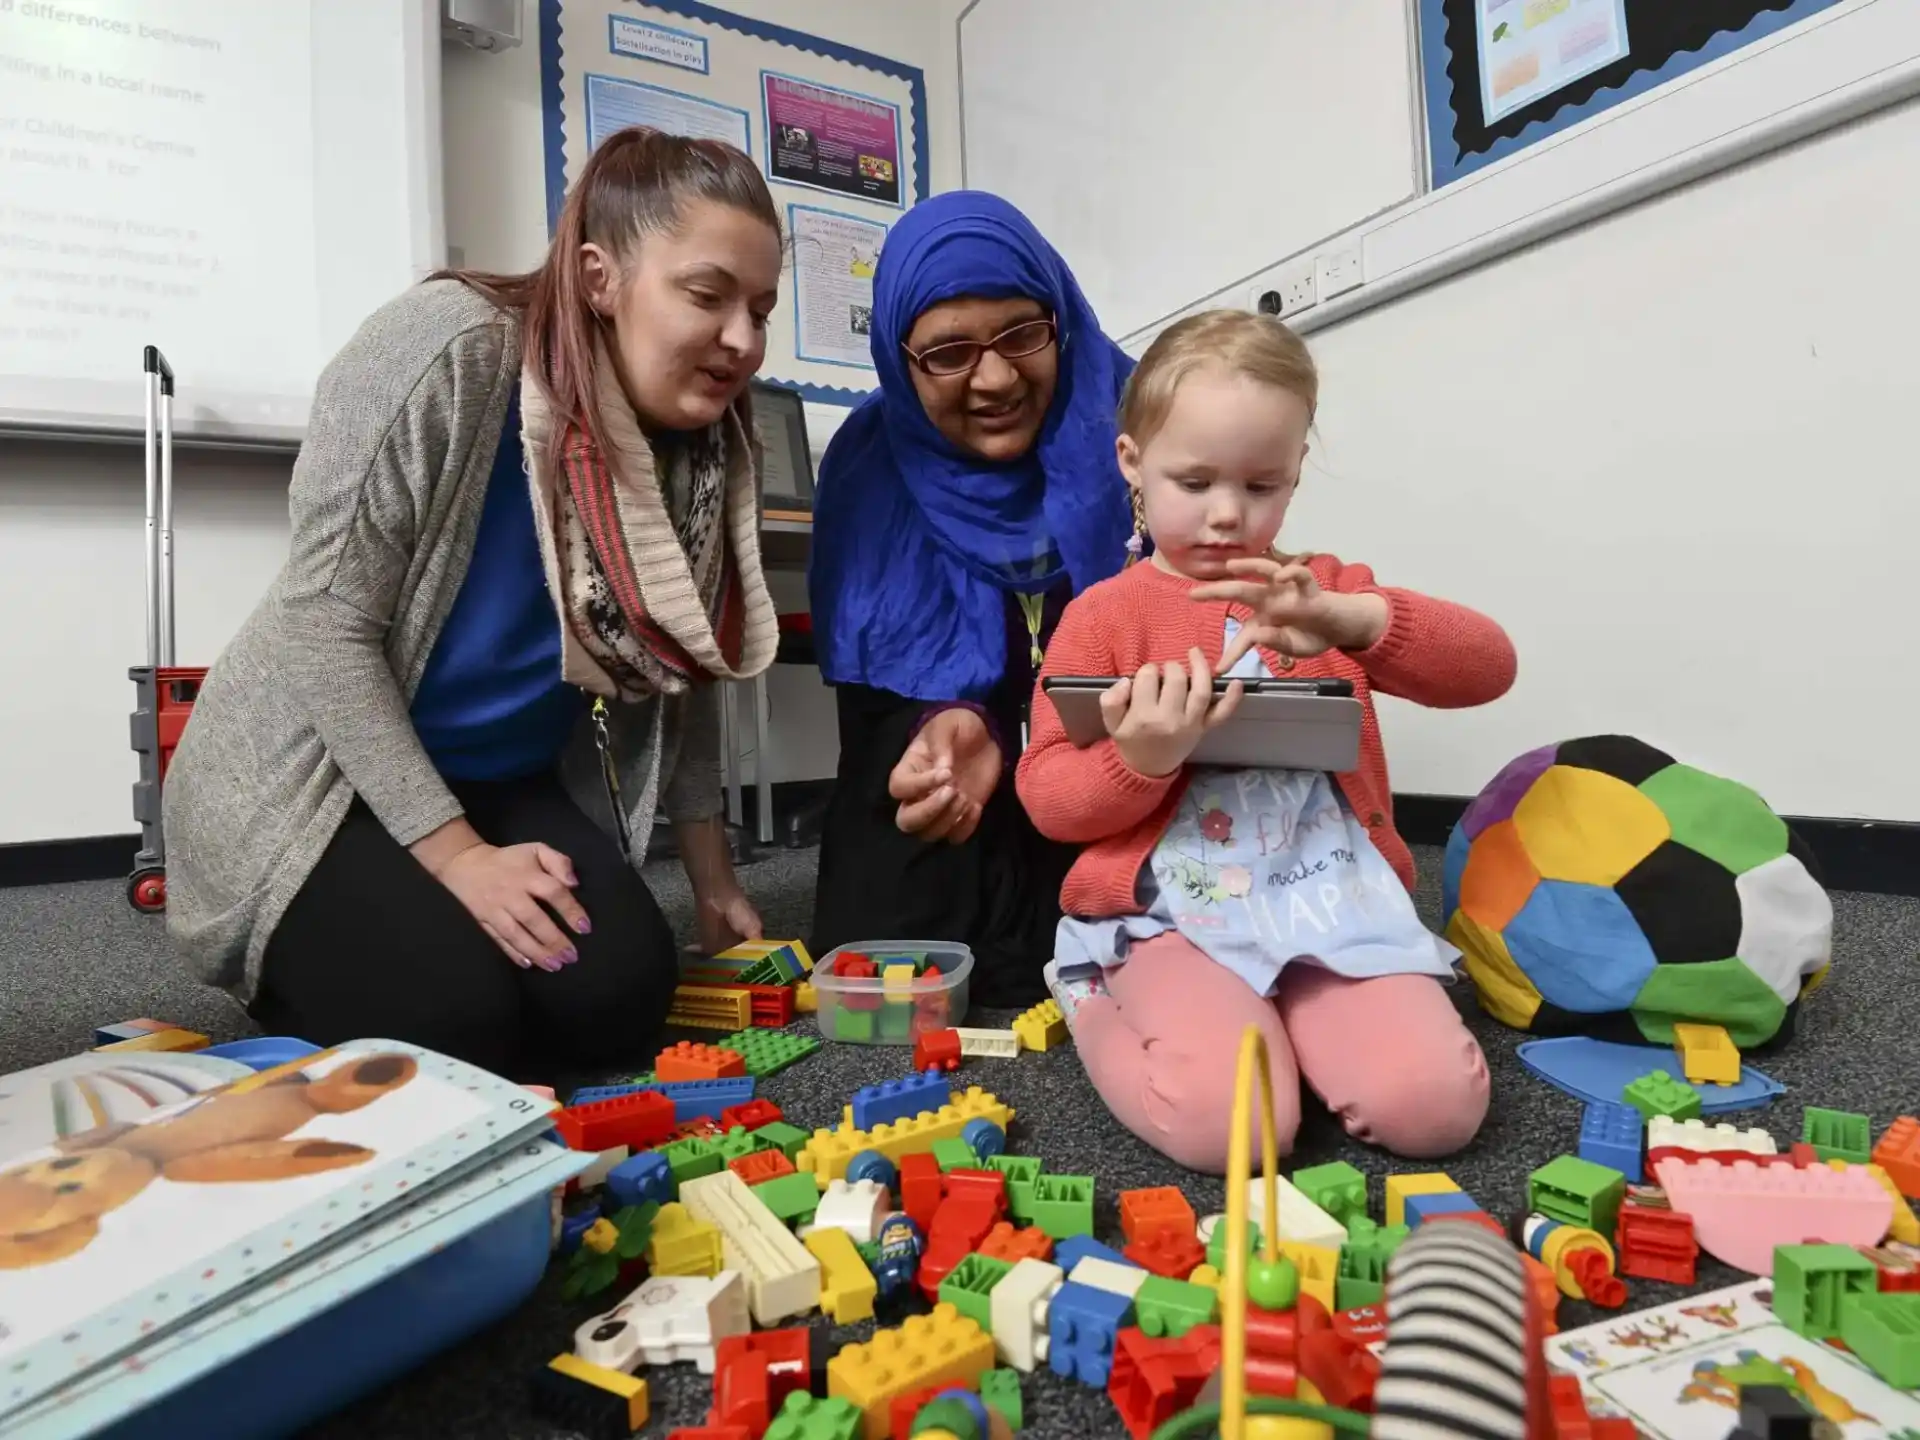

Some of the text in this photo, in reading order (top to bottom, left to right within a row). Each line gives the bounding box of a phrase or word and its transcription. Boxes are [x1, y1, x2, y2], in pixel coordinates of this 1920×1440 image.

[20, 2, 221, 53] differences between
[622, 23, 646, 37] Level
[655, 33, 694, 48] childcare
[673, 50, 683, 60] in
[684, 53, 703, 66] play
[57, 62, 75, 83] in
[80, 72, 92, 86] a
[98, 70, 144, 94] local
[1267, 860, 1329, 887] make
